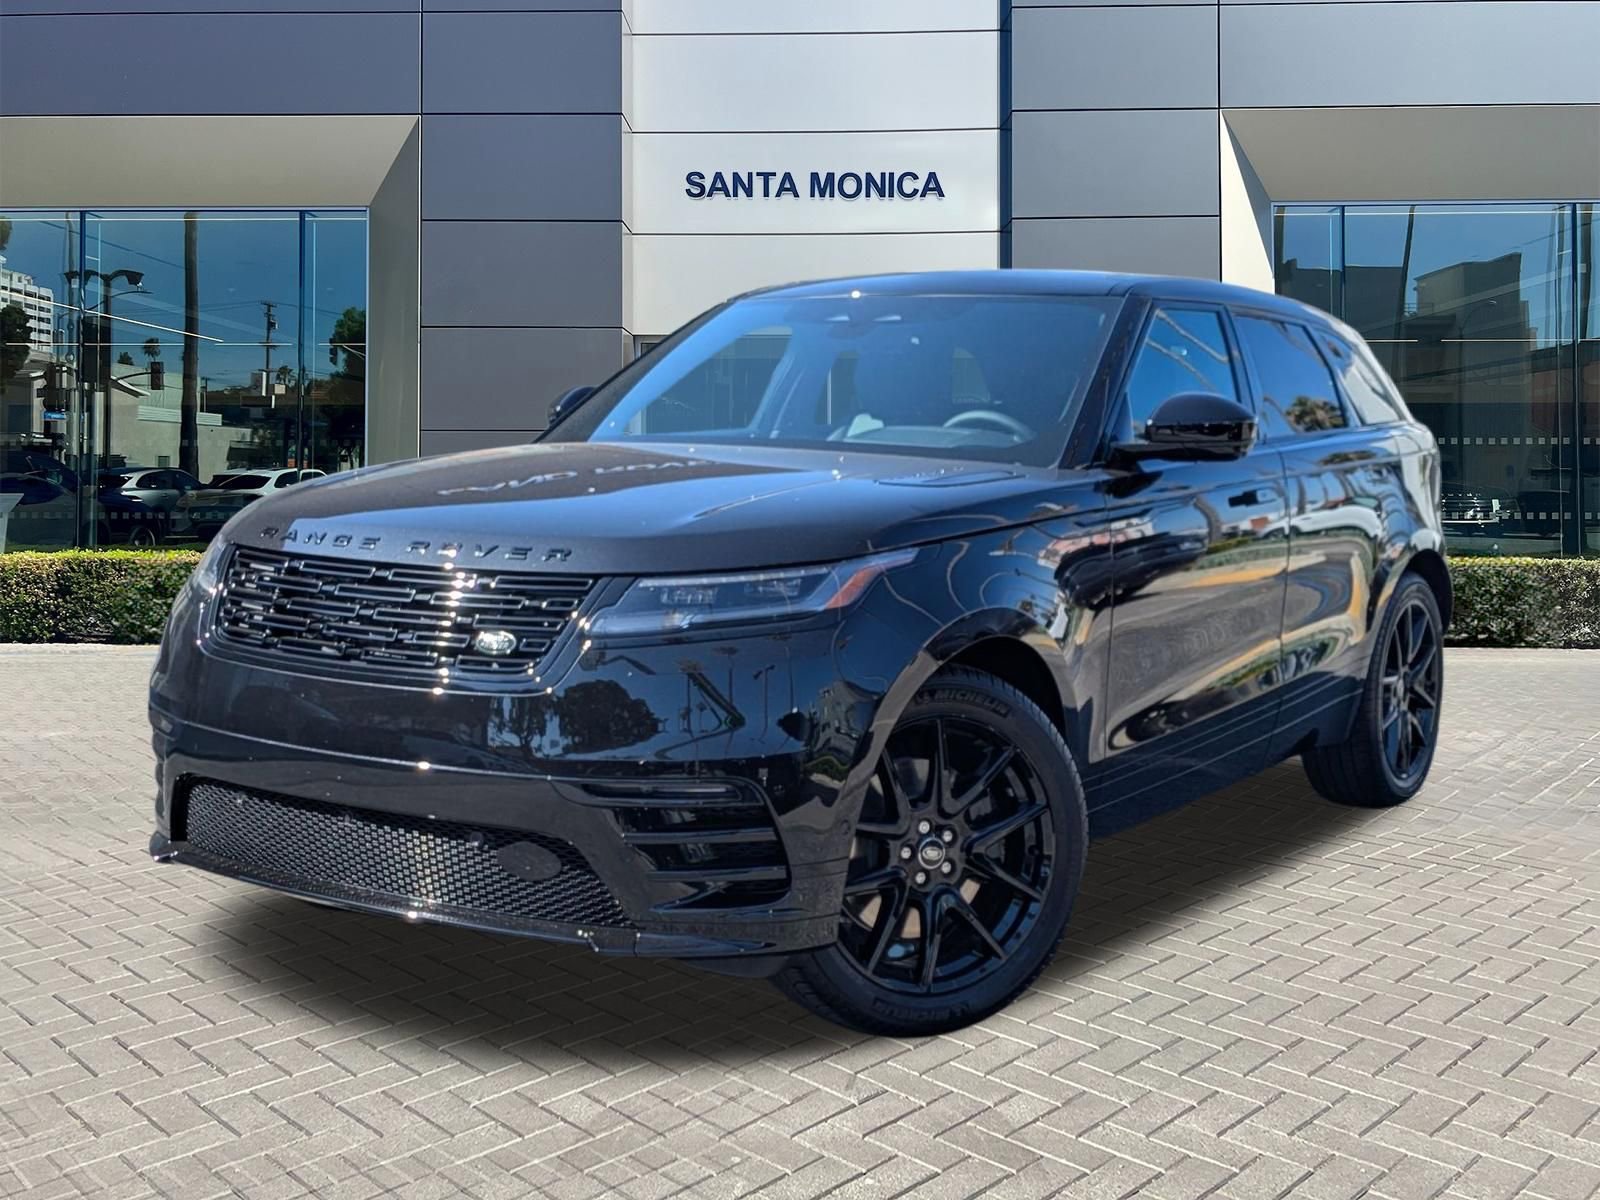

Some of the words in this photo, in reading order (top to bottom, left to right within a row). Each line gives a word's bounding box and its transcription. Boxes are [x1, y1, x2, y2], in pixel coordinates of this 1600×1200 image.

[685, 171, 800, 199] SANTA
[809, 171, 945, 199] MONICA
[260, 526, 381, 550] RANGE
[405, 540, 572, 562] ROVER
